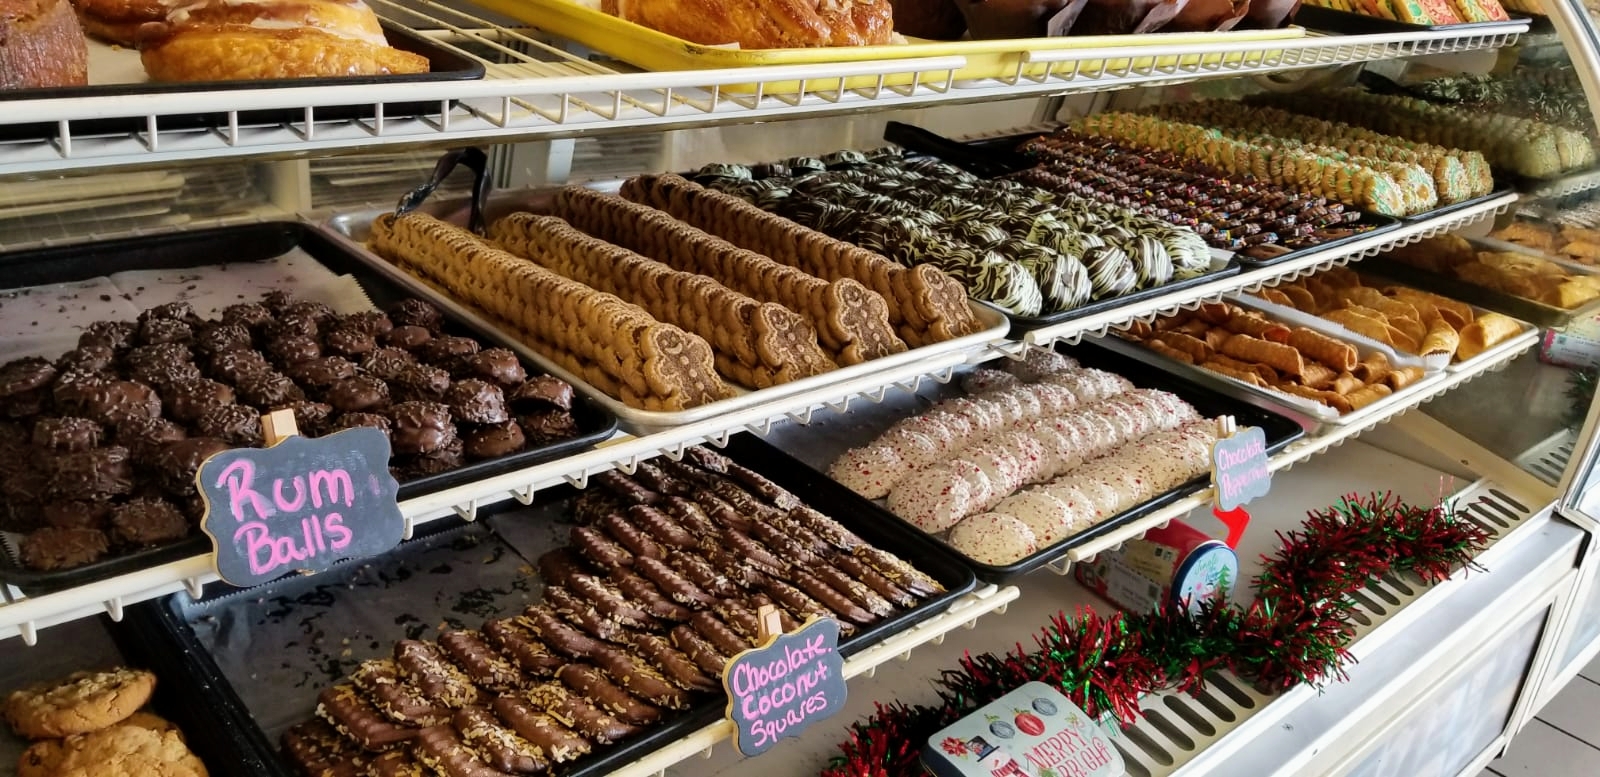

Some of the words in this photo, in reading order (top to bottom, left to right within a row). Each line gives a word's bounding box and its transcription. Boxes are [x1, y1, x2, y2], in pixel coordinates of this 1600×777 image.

[1218, 437, 1265, 471] Chocolate
[215, 458, 355, 522] Rum
[233, 512, 353, 576] Balls
[750, 691, 828, 747] Squares
[1023, 720, 1087, 768] MERRY
